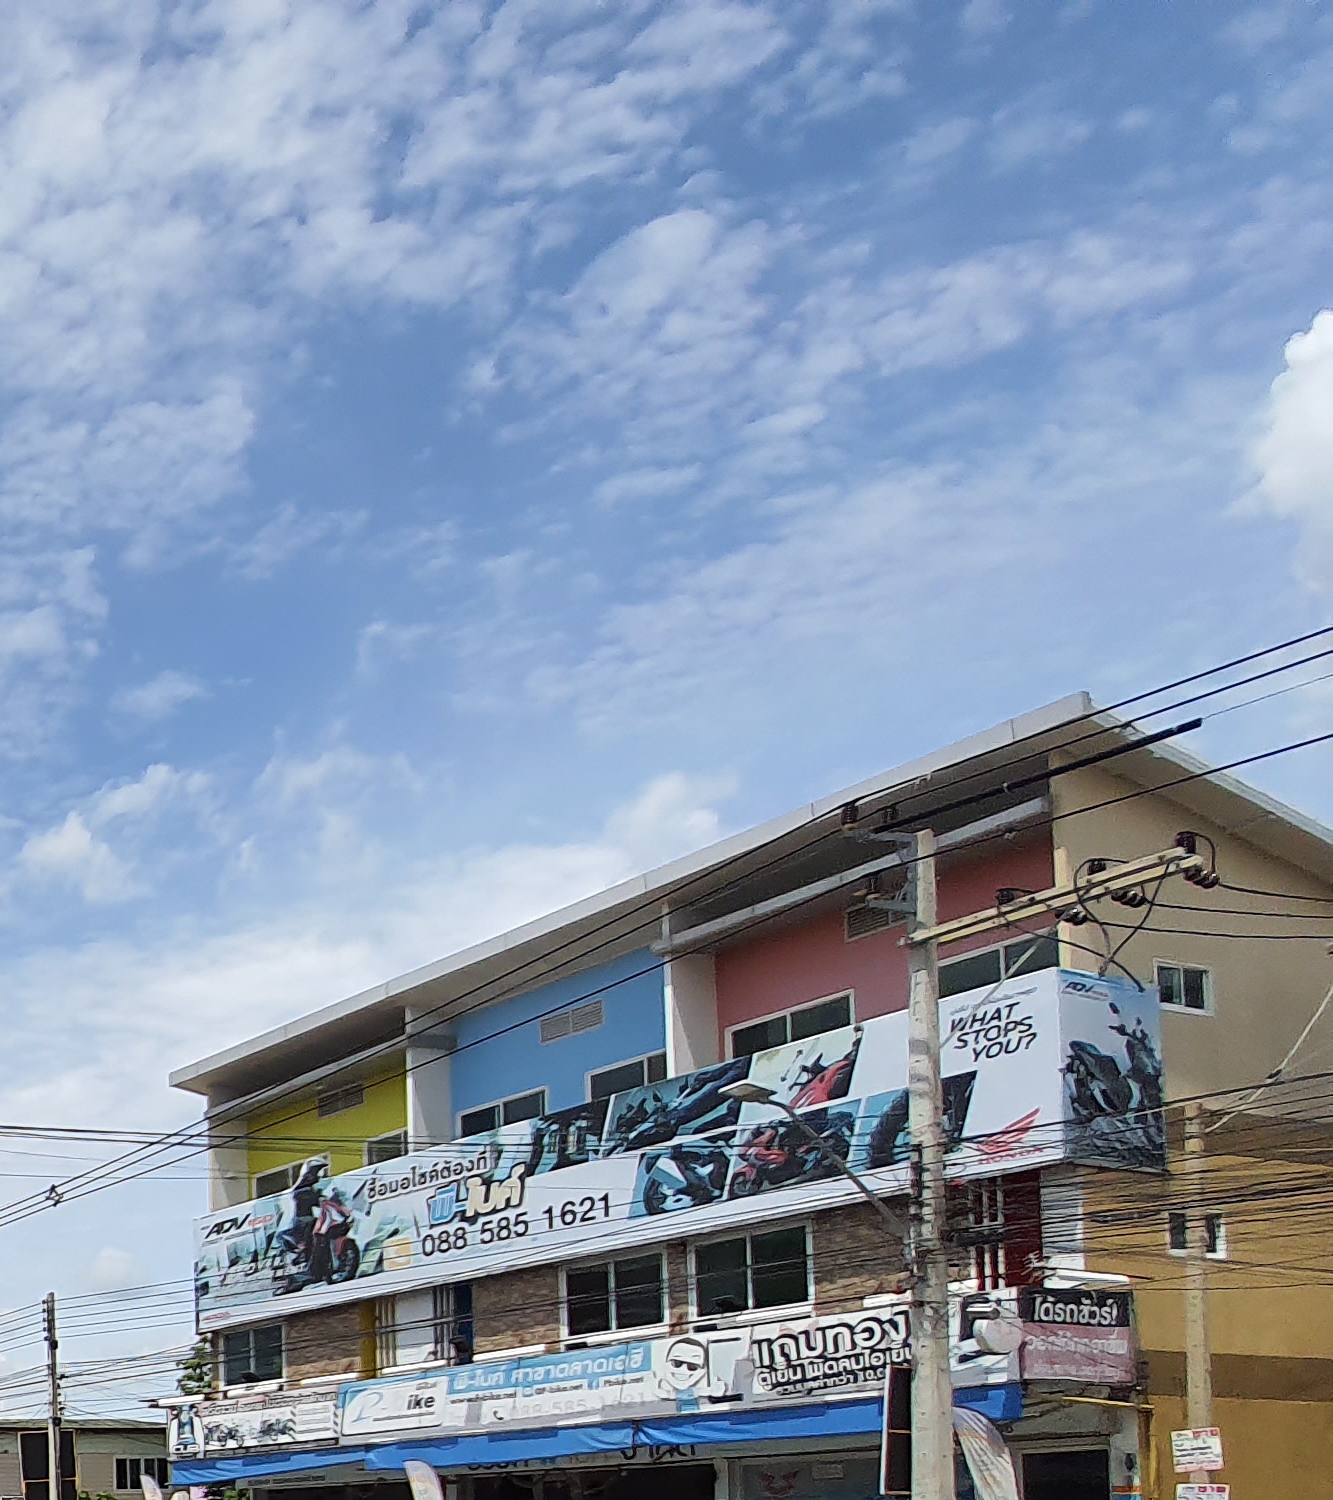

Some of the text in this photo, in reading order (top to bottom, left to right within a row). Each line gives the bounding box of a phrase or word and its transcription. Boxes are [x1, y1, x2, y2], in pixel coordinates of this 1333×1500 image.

[950, 1002, 1020, 1033] WHAT
[954, 1016, 1033, 1050] STOPS
[971, 1032, 1037, 1062] YOU?
[422, 1192, 610, 1256] 088 585 1621
[753, 1310, 908, 1367] แถมทอง
